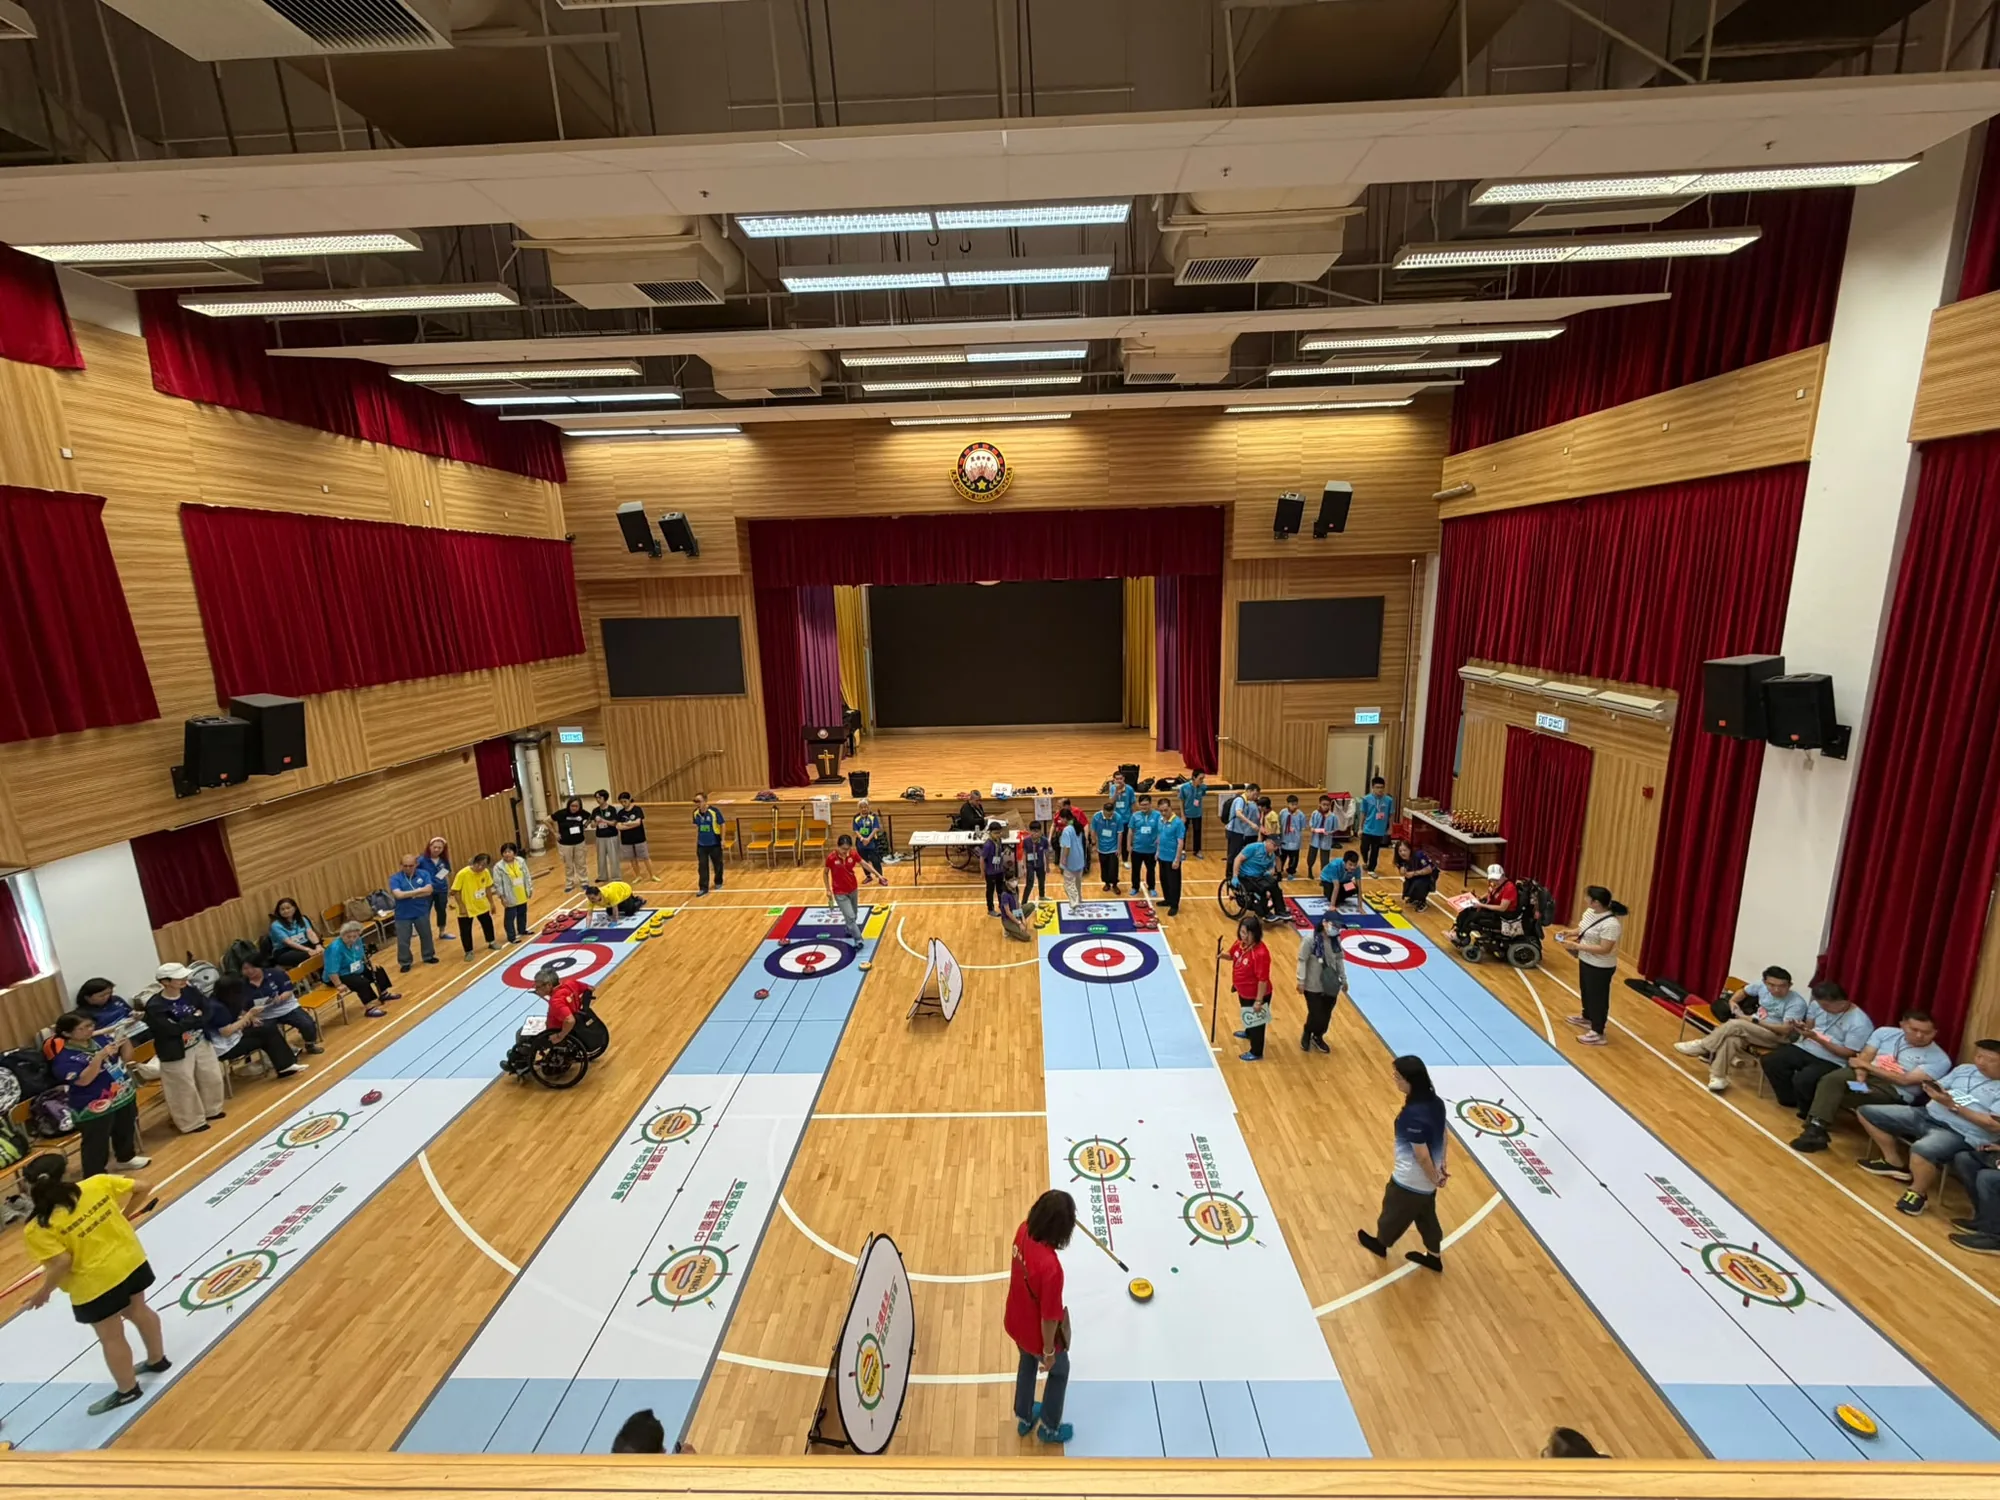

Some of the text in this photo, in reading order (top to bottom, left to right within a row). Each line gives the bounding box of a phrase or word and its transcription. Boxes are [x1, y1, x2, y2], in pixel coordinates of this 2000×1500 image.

[1185, 1153, 1205, 1190] 中國香港
[694, 1200, 724, 1242] 中國香港
[1105, 1184, 1123, 1225] 中國香港
